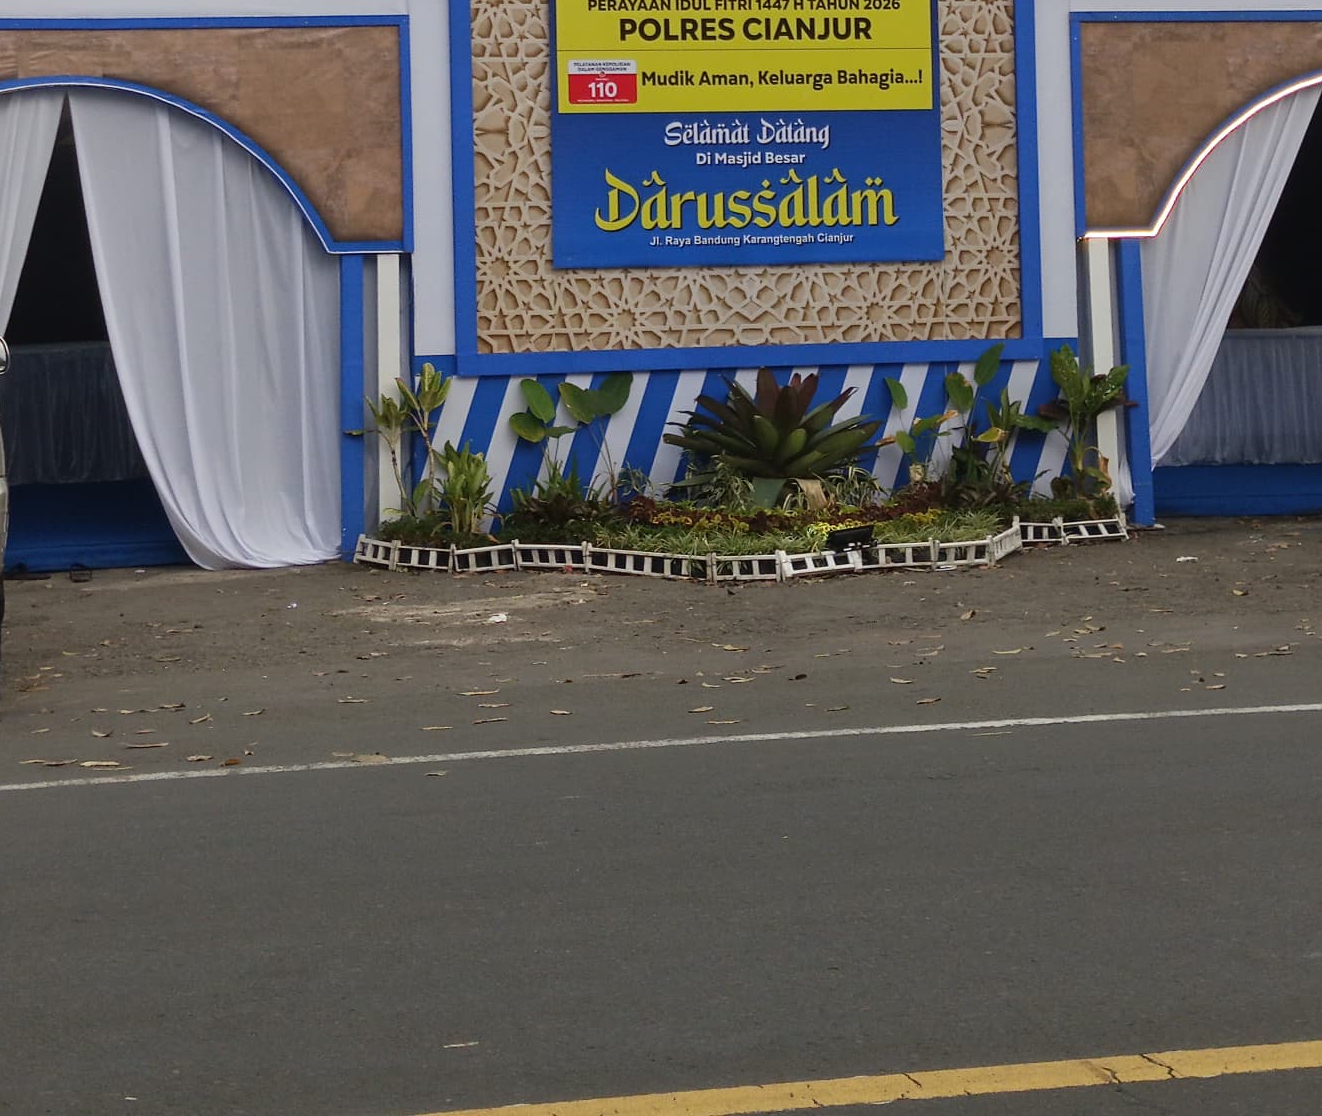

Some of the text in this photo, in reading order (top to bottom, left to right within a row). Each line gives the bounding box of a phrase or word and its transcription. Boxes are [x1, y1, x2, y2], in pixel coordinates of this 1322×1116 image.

[620, 17, 873, 41] POLRES CIANJUR
[642, 70, 695, 86] Mudik
[698, 71, 755, 88] Aman,
[758, 69, 834, 91] Keluarga
[588, 82, 618, 98] 110
[695, 152, 806, 168] Di Masjid Besar
[649, 233, 855, 248] Jl. Raya Bandung Karangtengah Cianjur
